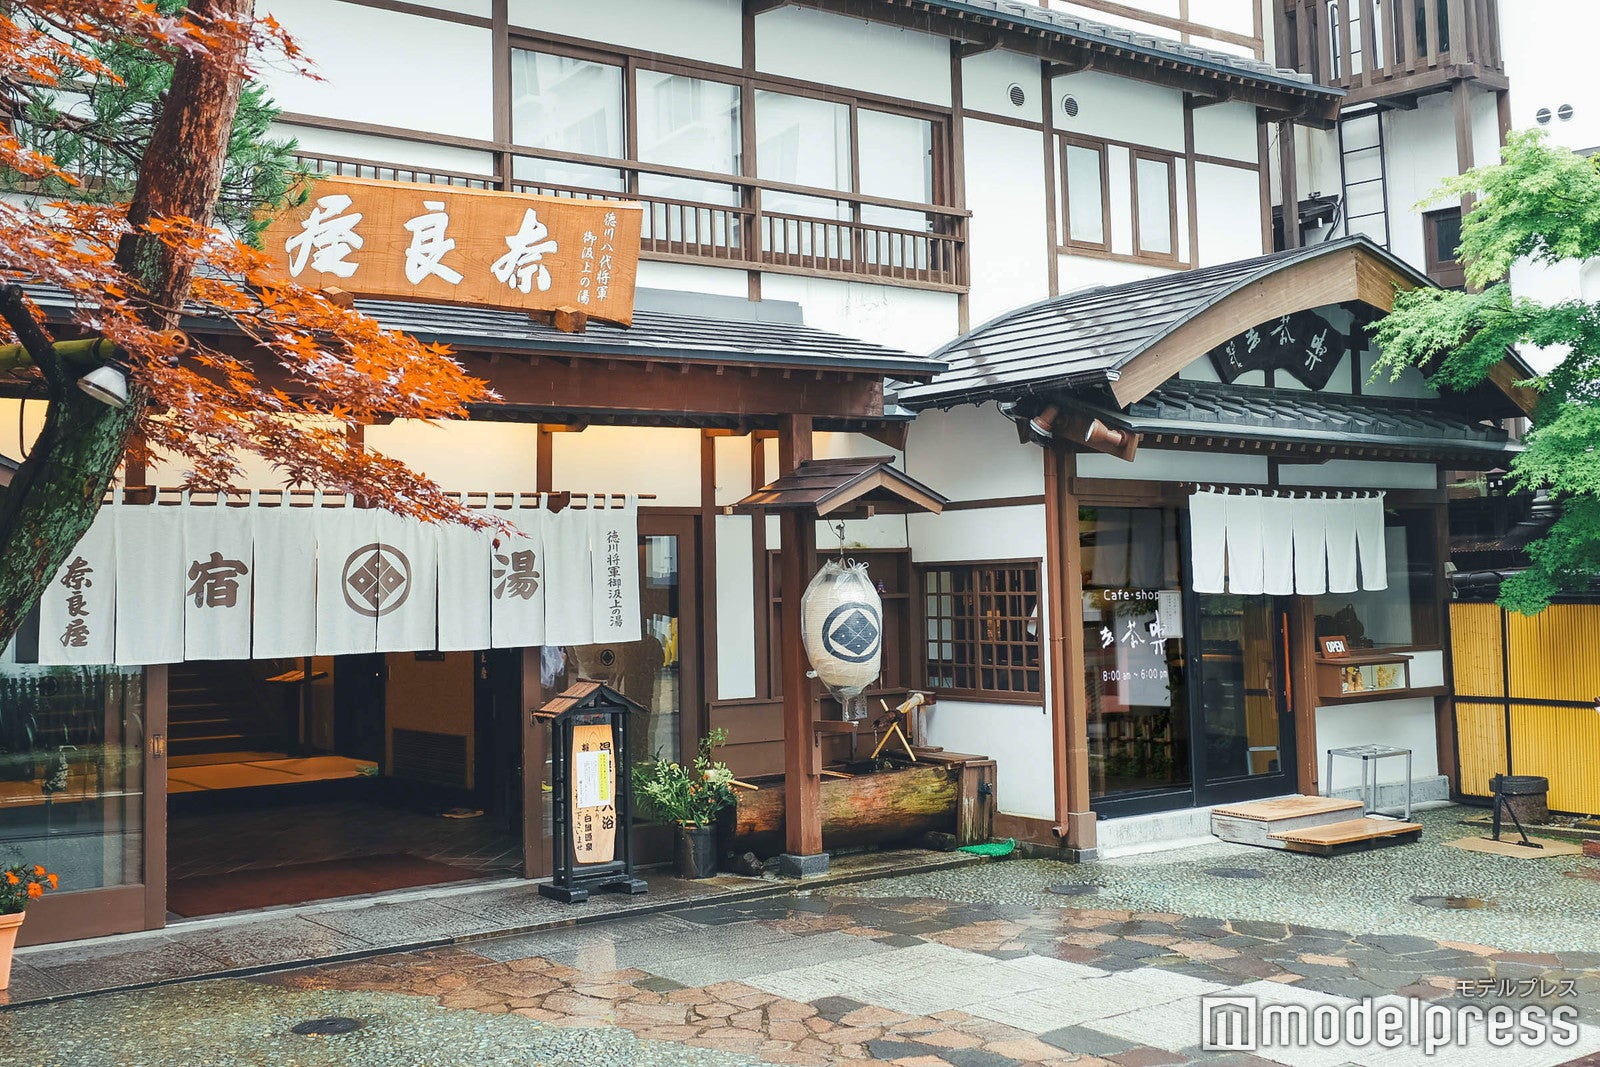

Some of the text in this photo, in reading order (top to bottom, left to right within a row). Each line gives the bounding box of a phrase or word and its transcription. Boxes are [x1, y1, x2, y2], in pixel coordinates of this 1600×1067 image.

[577, 230, 597, 305] 御汲上の湯
[596, 212, 617, 301] 徳川八代将軍
[60, 556, 93, 647] 奈良屋
[186, 551, 249, 609] 宿
[492, 551, 541, 601] 湯
[607, 529, 623, 628] 徳川将軍御汲上の湯
[1102, 670, 1121, 682] 8:00
[1140, 668, 1157, 679] 6:00
[1325, 640, 1346, 653] OPEN
